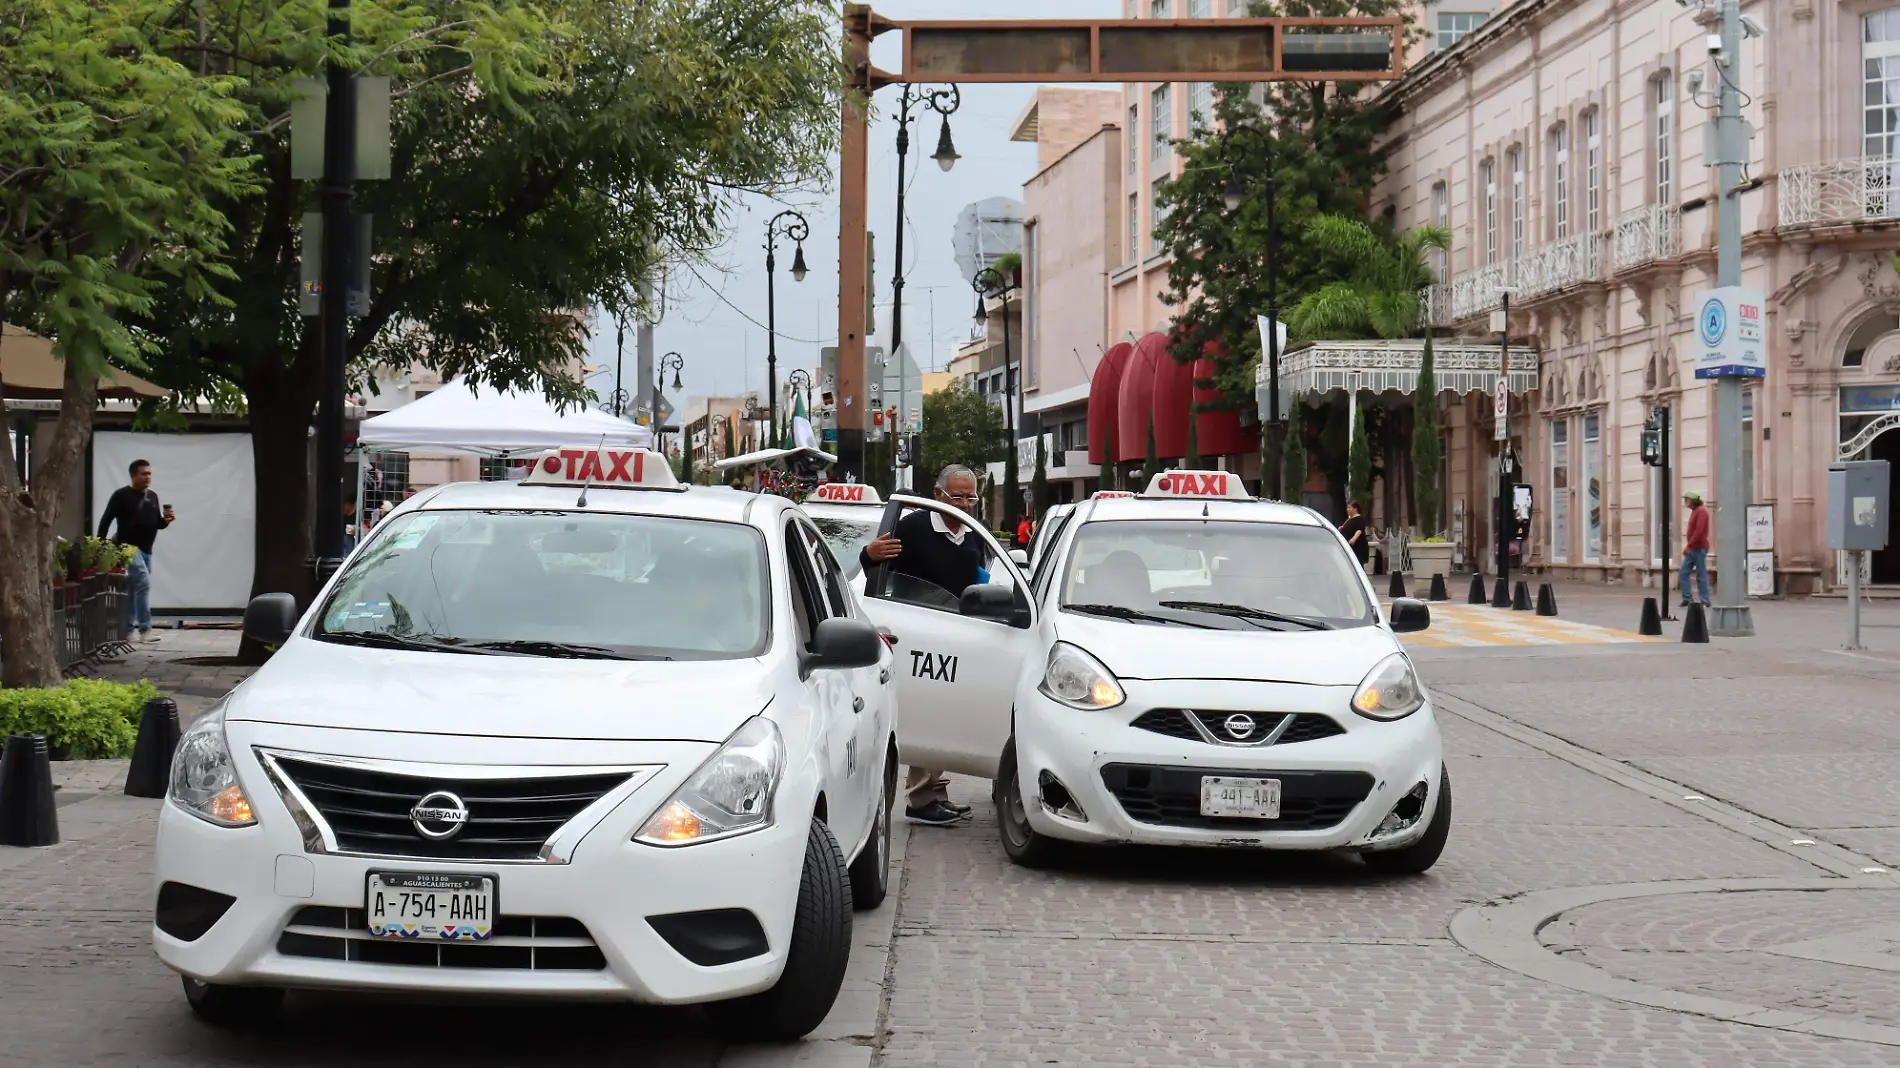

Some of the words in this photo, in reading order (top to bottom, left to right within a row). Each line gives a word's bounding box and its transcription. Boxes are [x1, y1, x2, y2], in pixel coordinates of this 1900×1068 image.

[560, 450, 643, 481] TAXI
[827, 486, 863, 500] TAXI
[1168, 474, 1226, 495] TAXI
[910, 650, 958, 683] TAXI
[415, 809, 461, 820] NISSAN
[374, 892, 487, 920] A-754-AAH
